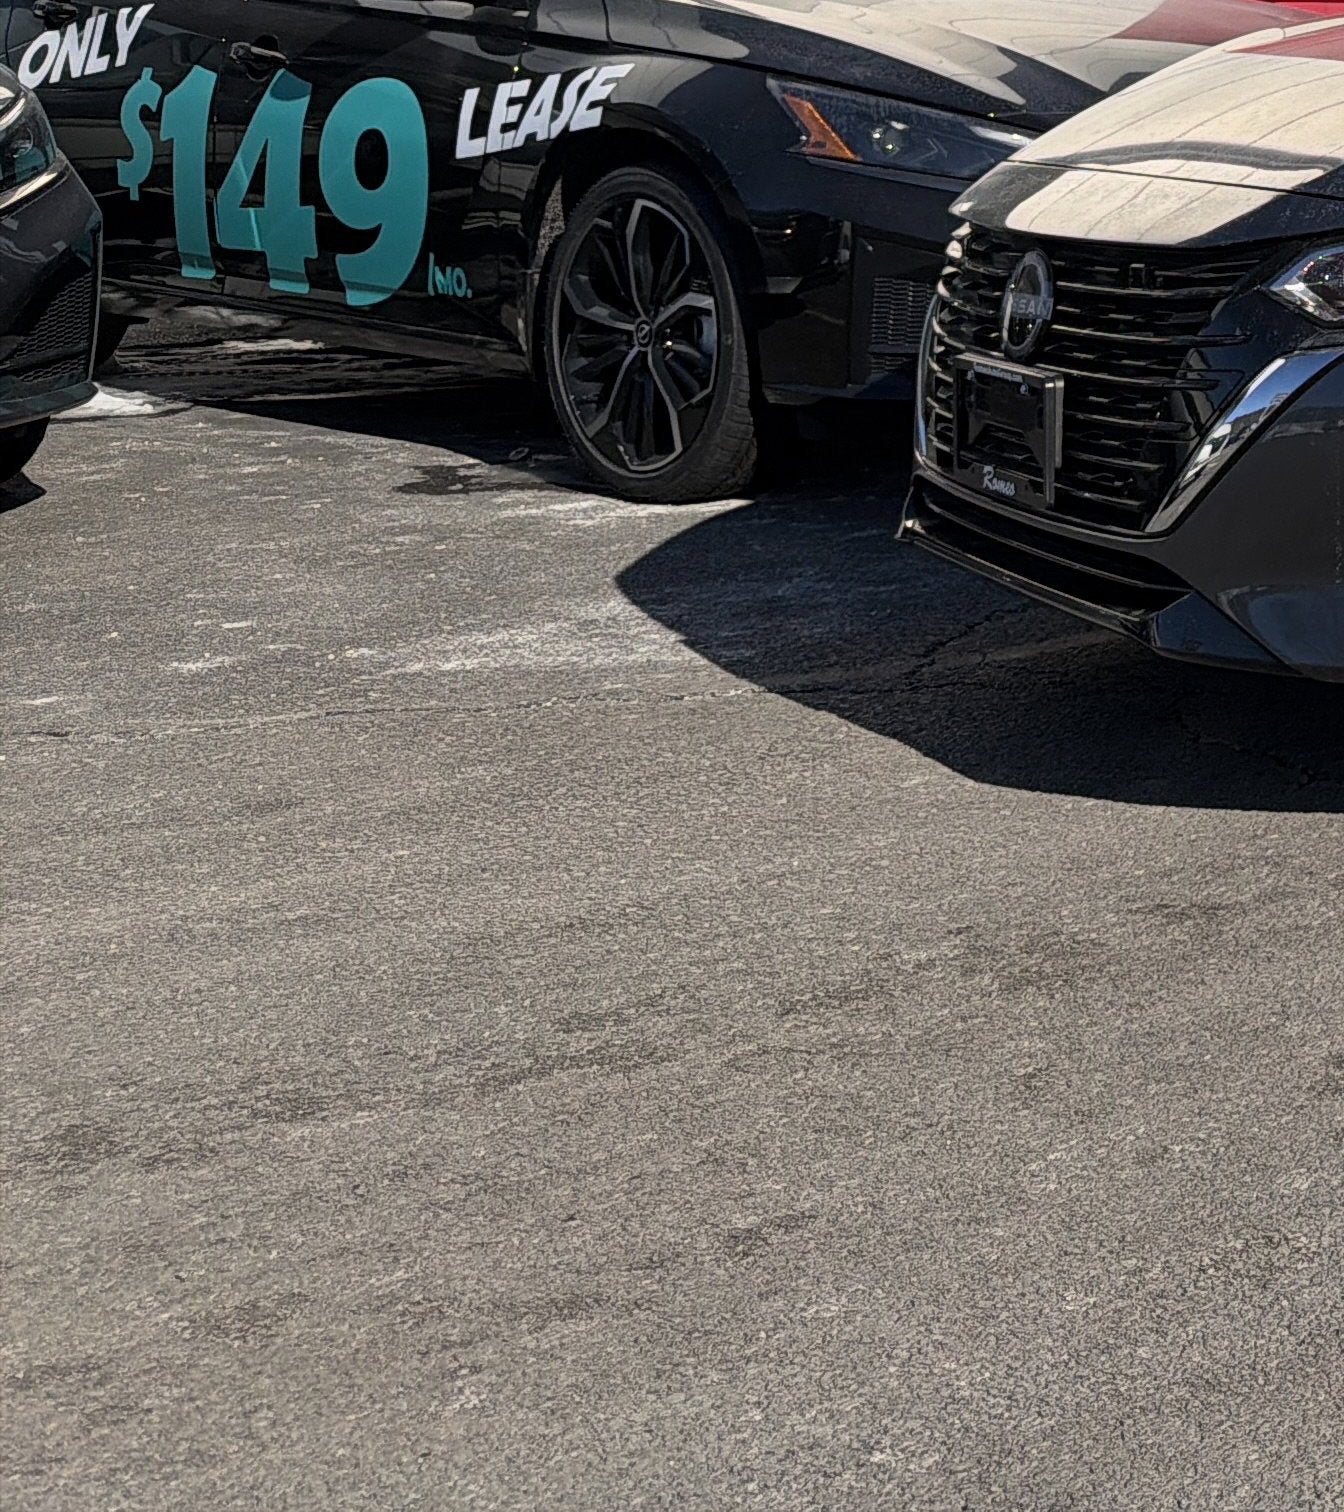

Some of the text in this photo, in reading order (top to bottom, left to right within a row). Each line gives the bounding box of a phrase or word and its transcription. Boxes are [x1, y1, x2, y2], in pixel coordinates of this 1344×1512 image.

[17, 2, 156, 89] ONLY
[454, 62, 635, 159] LEASE
[116, 64, 430, 307] $149
